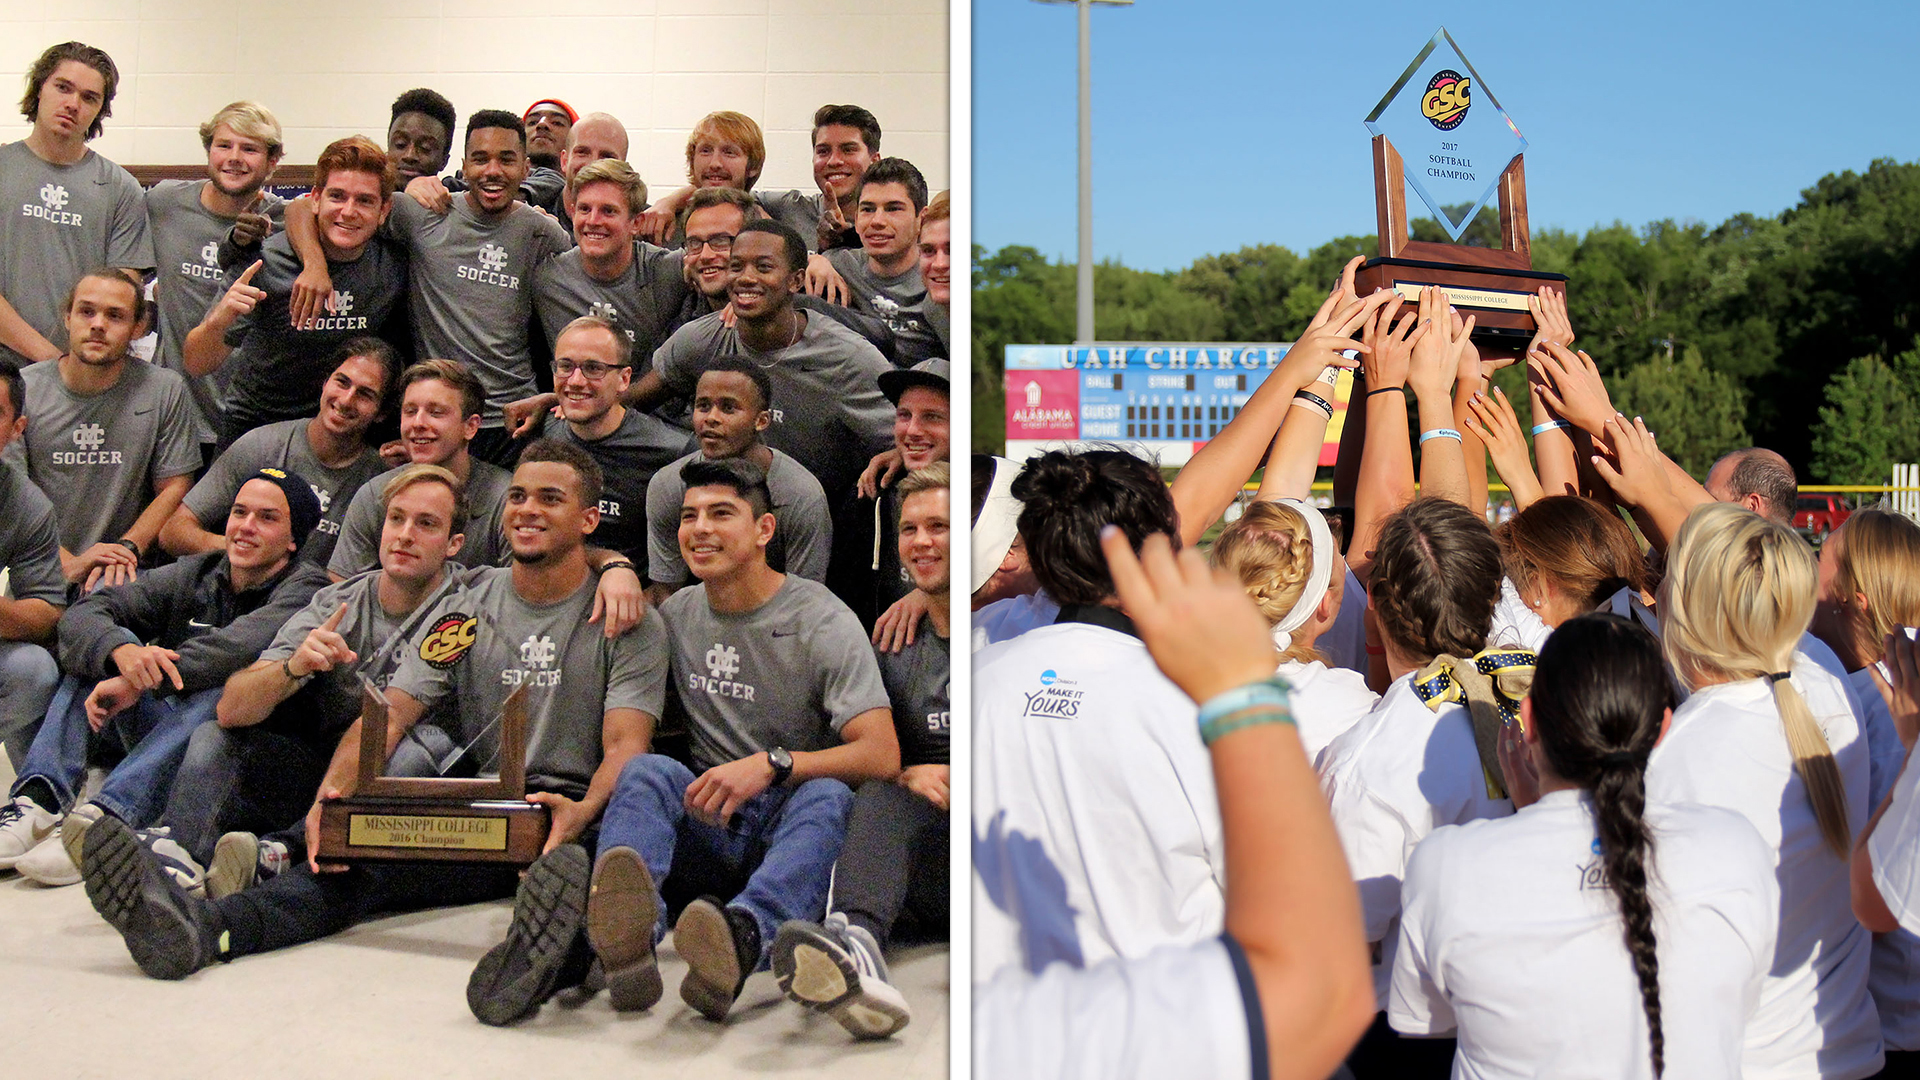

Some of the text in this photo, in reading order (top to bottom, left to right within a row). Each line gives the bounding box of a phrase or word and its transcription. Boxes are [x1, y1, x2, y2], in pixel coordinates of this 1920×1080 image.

[1421, 78, 1470, 118] GSC
[1441, 141, 1458, 151] 2017
[1429, 154, 1472, 168] SOFTBALL
[1427, 167, 1476, 181] CHAMPION
[22, 203, 82, 227] SOCCER
[181, 262, 224, 281] SOCC
[456, 265, 520, 290] SOCCER
[1450, 293, 1509, 305] MISSISSIPPI COLLEGE
[1060, 347, 1281, 370] UAH CHARGE
[1013, 408, 1073, 423] ALABAMA
[1081, 403, 1122, 420] GUEST
[1082, 423, 1120, 437] HOME
[52, 451, 122, 464] SOCCER
[420, 617, 477, 661] GSC
[689, 673, 755, 702] SOCCER
[1046, 688, 1085, 699] MAKE IT
[1023, 689, 1081, 717] YOURS
[364, 817, 492, 834] MISSISSIPPI COLLEGE
[389, 832, 465, 847] 2016 Champion
